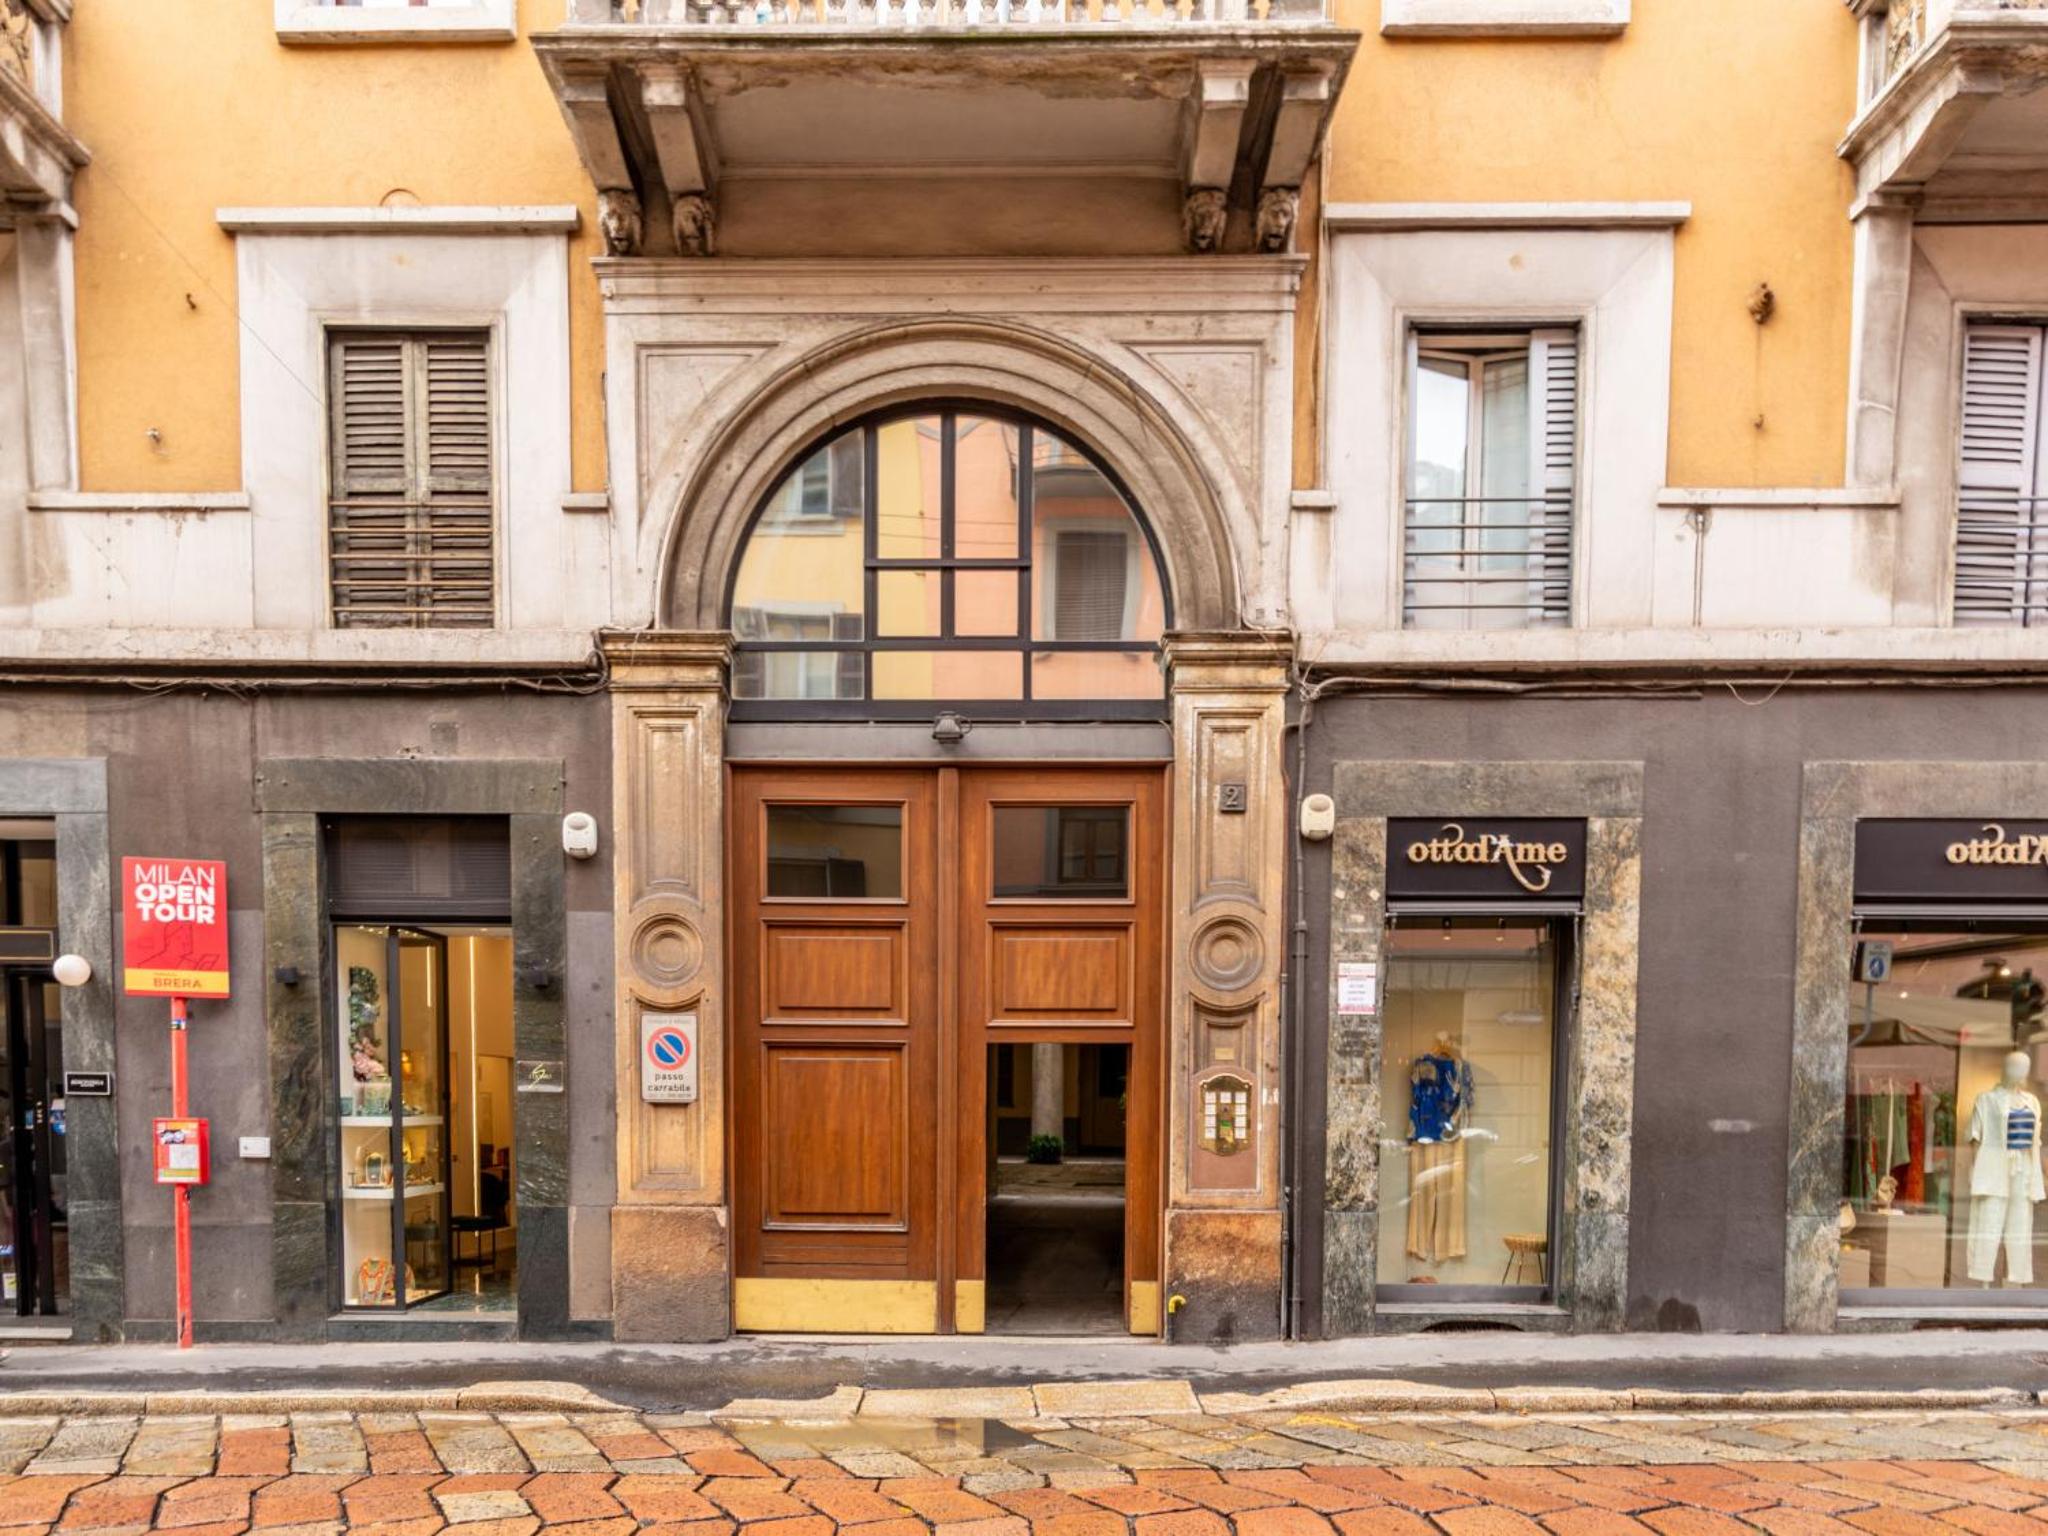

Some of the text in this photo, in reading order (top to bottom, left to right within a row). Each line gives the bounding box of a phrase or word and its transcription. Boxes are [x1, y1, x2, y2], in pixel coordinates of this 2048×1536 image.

[1225, 786, 1239, 806] 2
[134, 863, 215, 886] MILAN
[134, 883, 215, 906] OPEN
[136, 902, 215, 925] TOUR
[153, 977, 202, 989] BRERA
[647, 1083, 691, 1092] carrabile
[655, 1073, 684, 1082] passo
